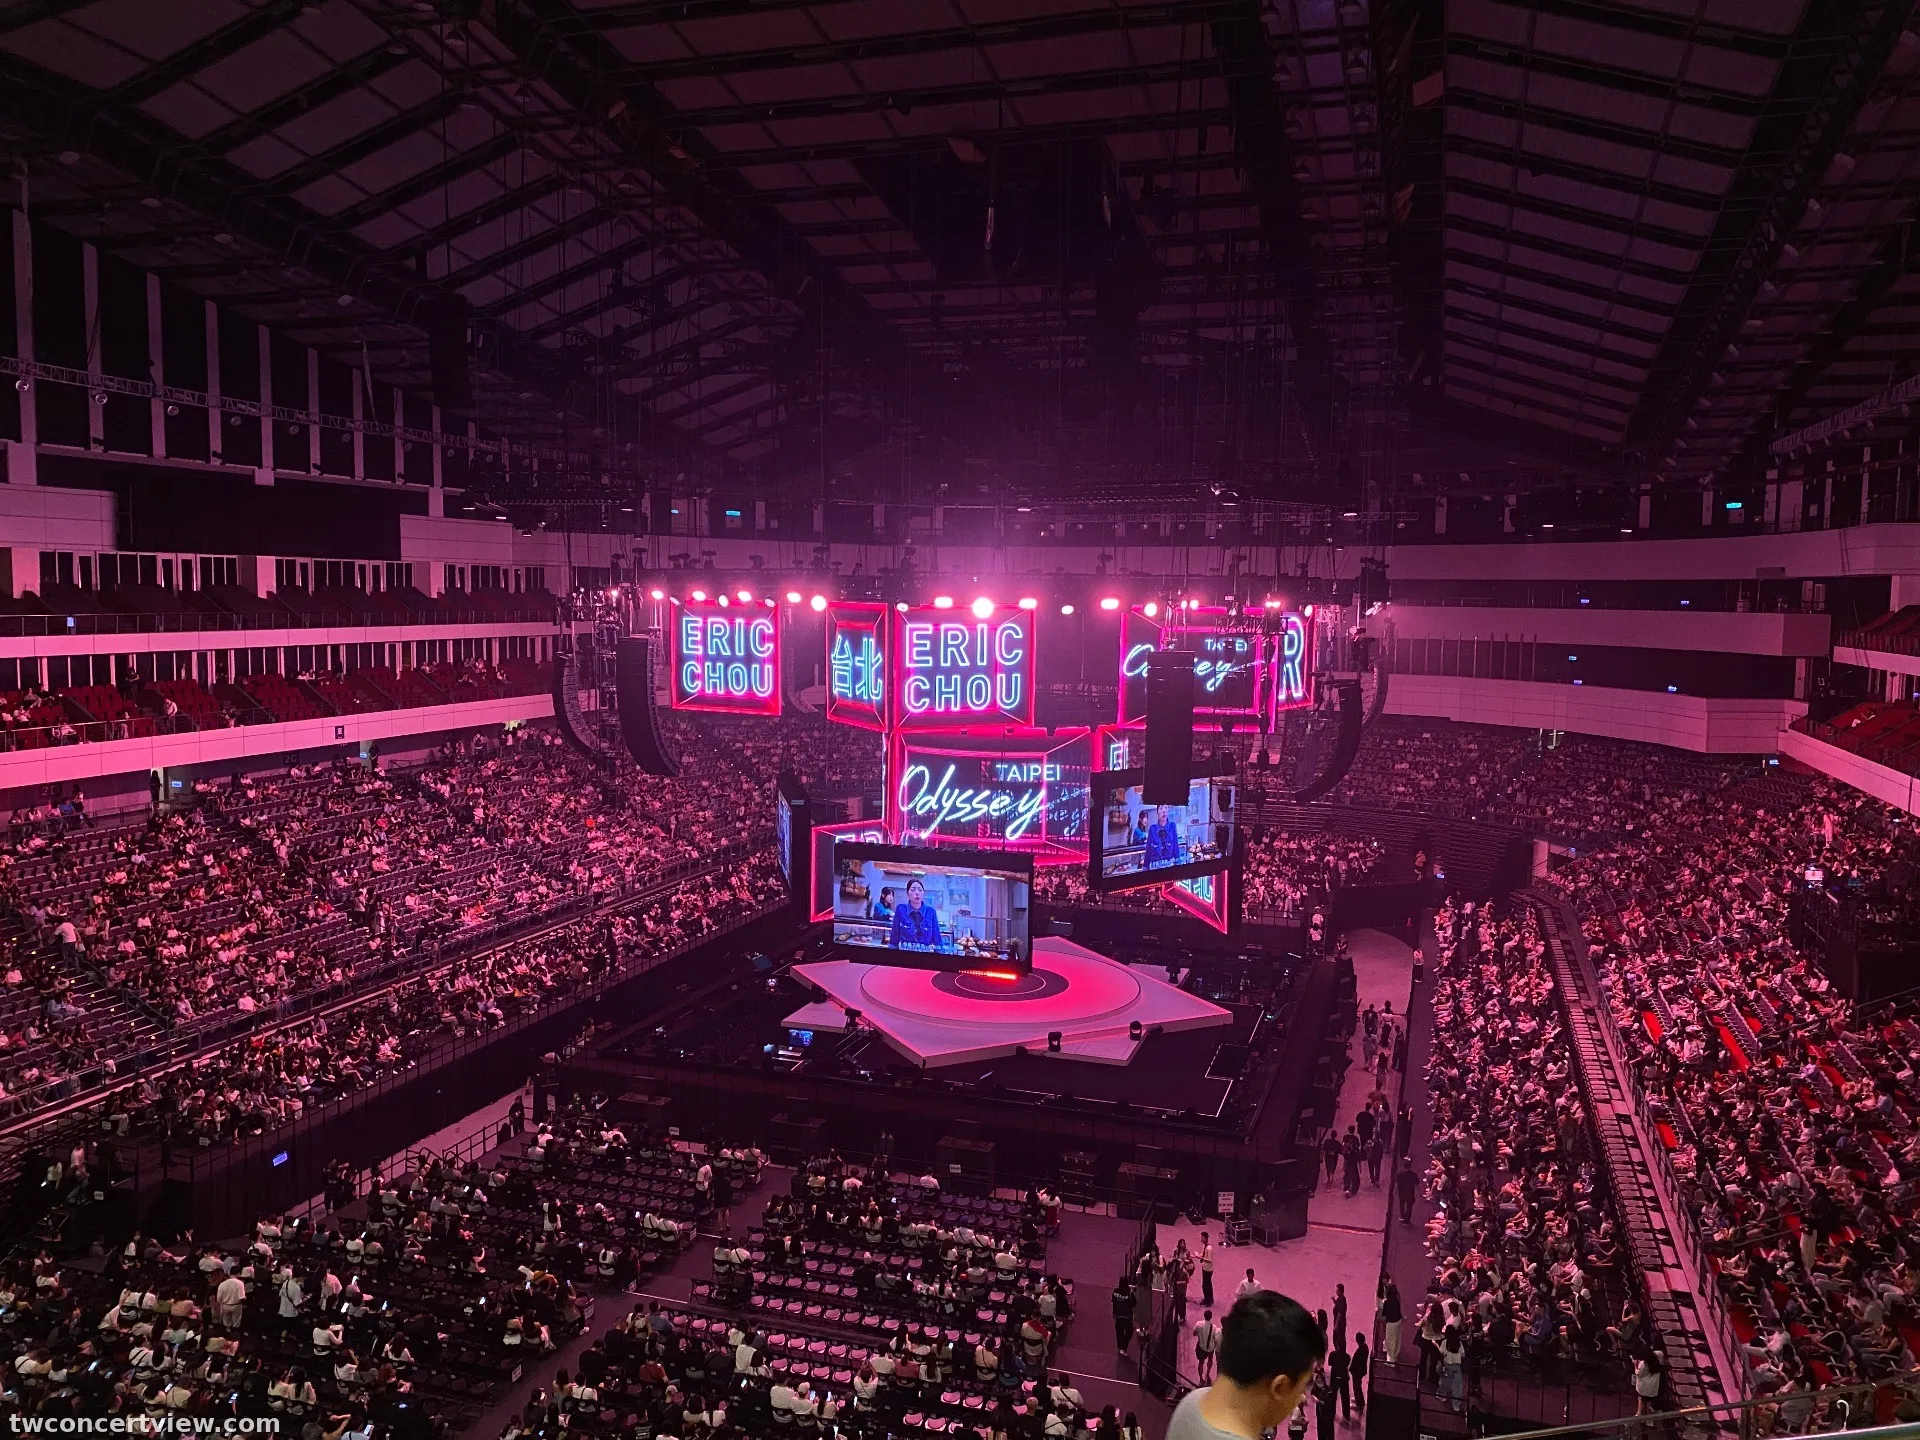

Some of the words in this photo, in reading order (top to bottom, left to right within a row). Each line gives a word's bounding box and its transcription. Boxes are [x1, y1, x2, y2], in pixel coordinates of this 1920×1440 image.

[682, 616, 775, 657] ERIC
[903, 622, 1024, 668] ERIC
[682, 661, 775, 698] CHOU
[831, 634, 883, 702] 台北
[902, 672, 1023, 714] CHOU
[995, 763, 1061, 782] TAIPEI
[898, 763, 1050, 841] Odyssey
